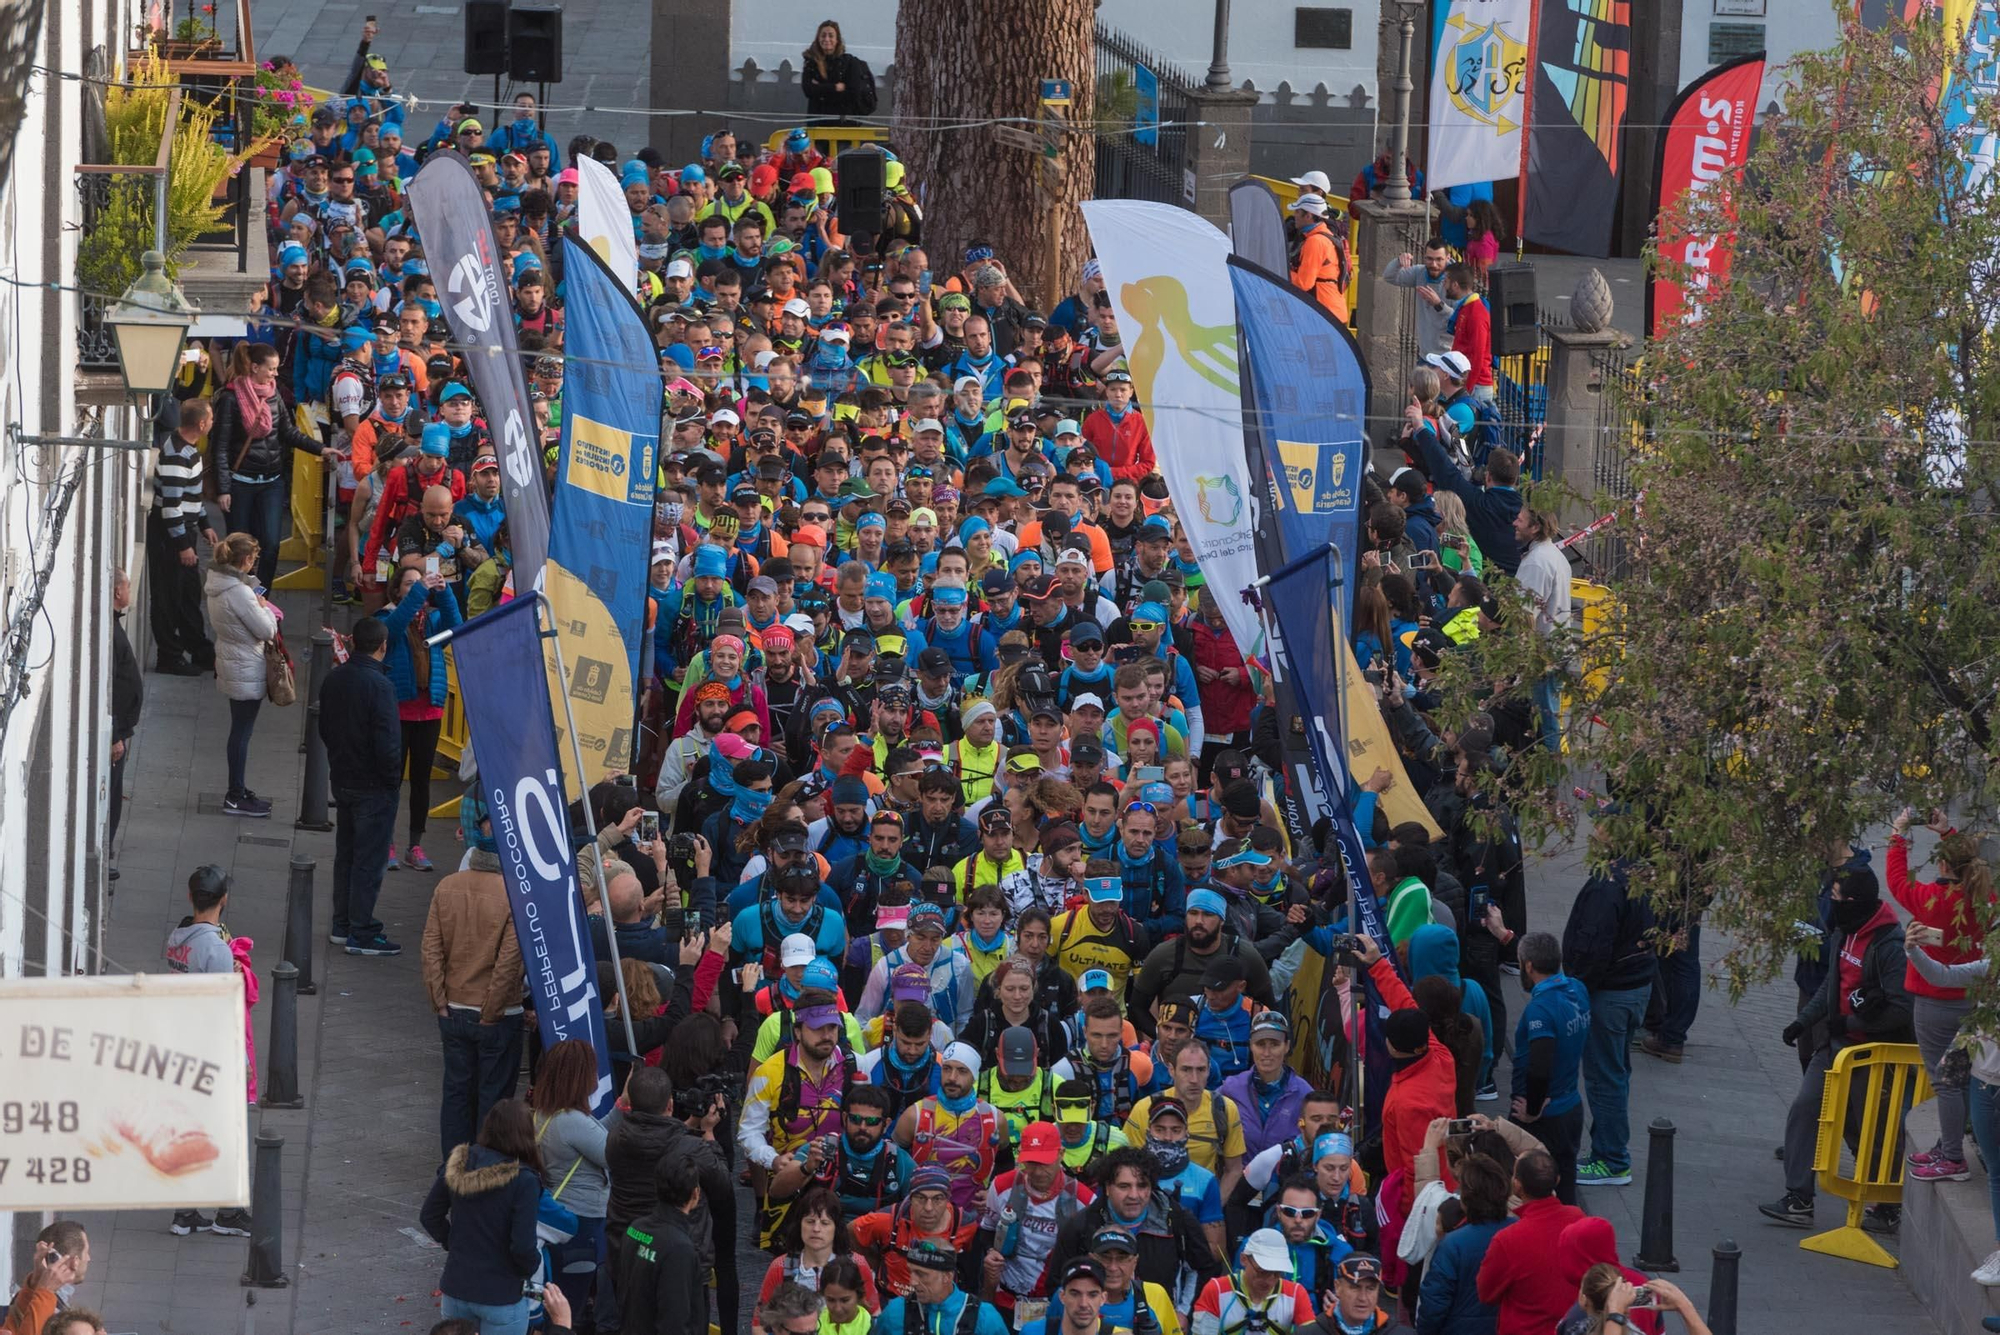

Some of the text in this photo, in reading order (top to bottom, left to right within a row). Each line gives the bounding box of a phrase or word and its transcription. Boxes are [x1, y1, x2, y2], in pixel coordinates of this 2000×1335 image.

[1730, 99, 1746, 158] NUTRITION
[1291, 796, 1304, 836] SPORT
[1069, 953, 1127, 971] ULTIMATE
[19, 1024, 221, 1097] DE TUNTE
[3, 1100, 80, 1134] 948
[25, 1157, 92, 1184] 428
